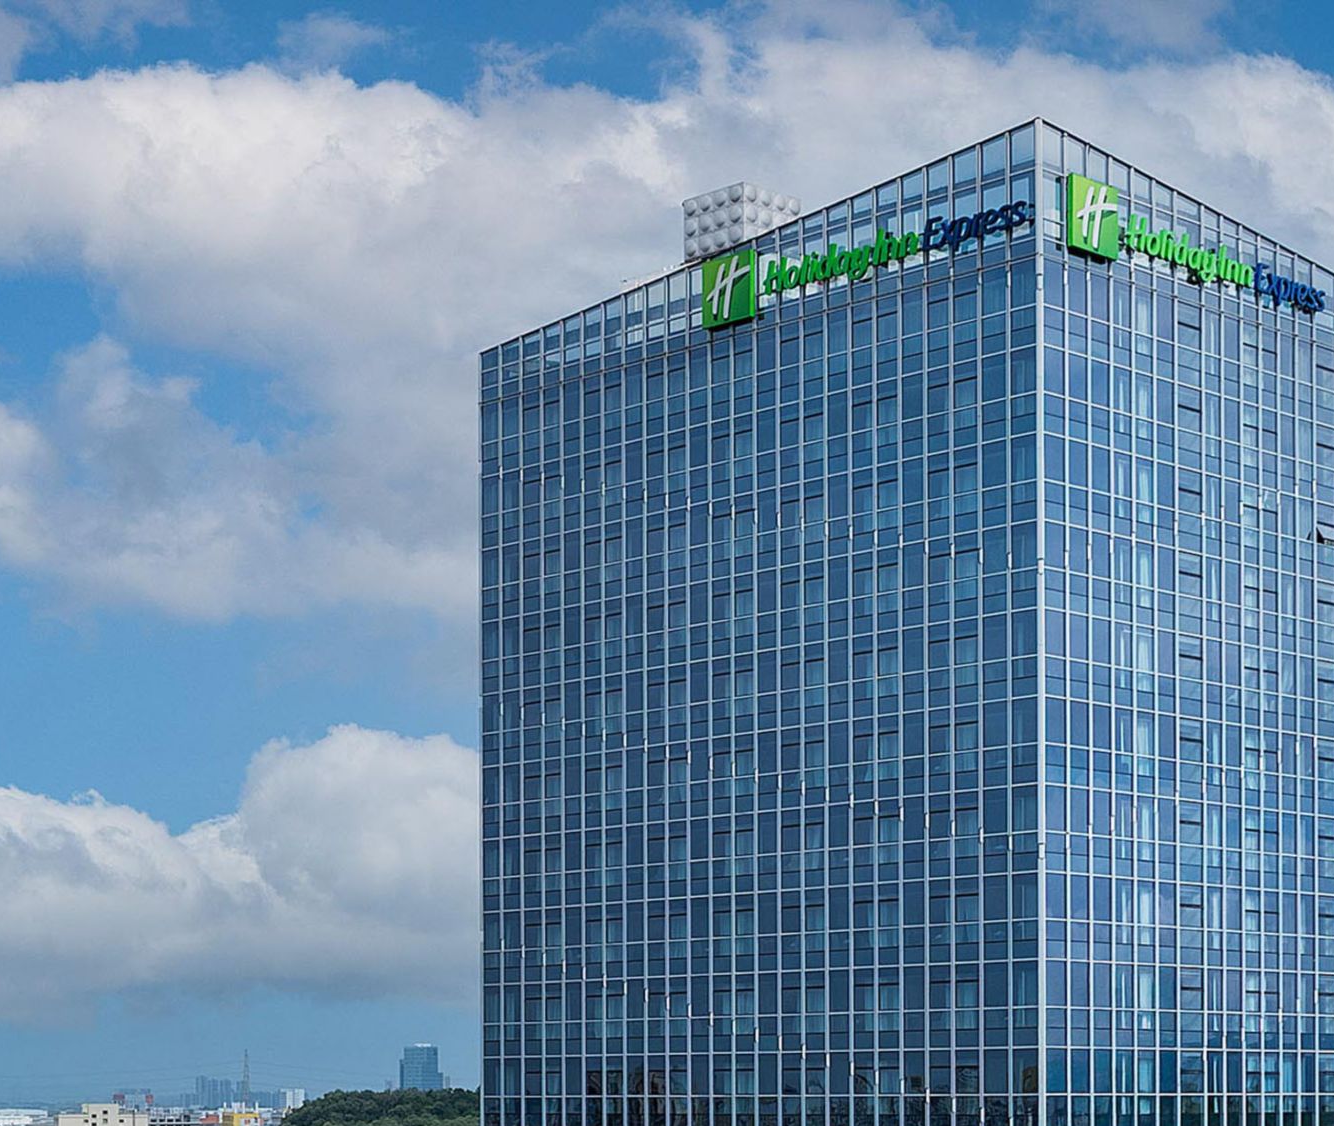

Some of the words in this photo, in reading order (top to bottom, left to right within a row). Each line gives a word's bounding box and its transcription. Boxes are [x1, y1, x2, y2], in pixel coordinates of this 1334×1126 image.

[763, 243, 870, 296] Holiday
[873, 227, 919, 267] Inn
[922, 200, 1027, 252] Express
[1124, 213, 1217, 282] Holiday
[1218, 244, 1254, 287] Inn
[1255, 262, 1326, 312] Express
